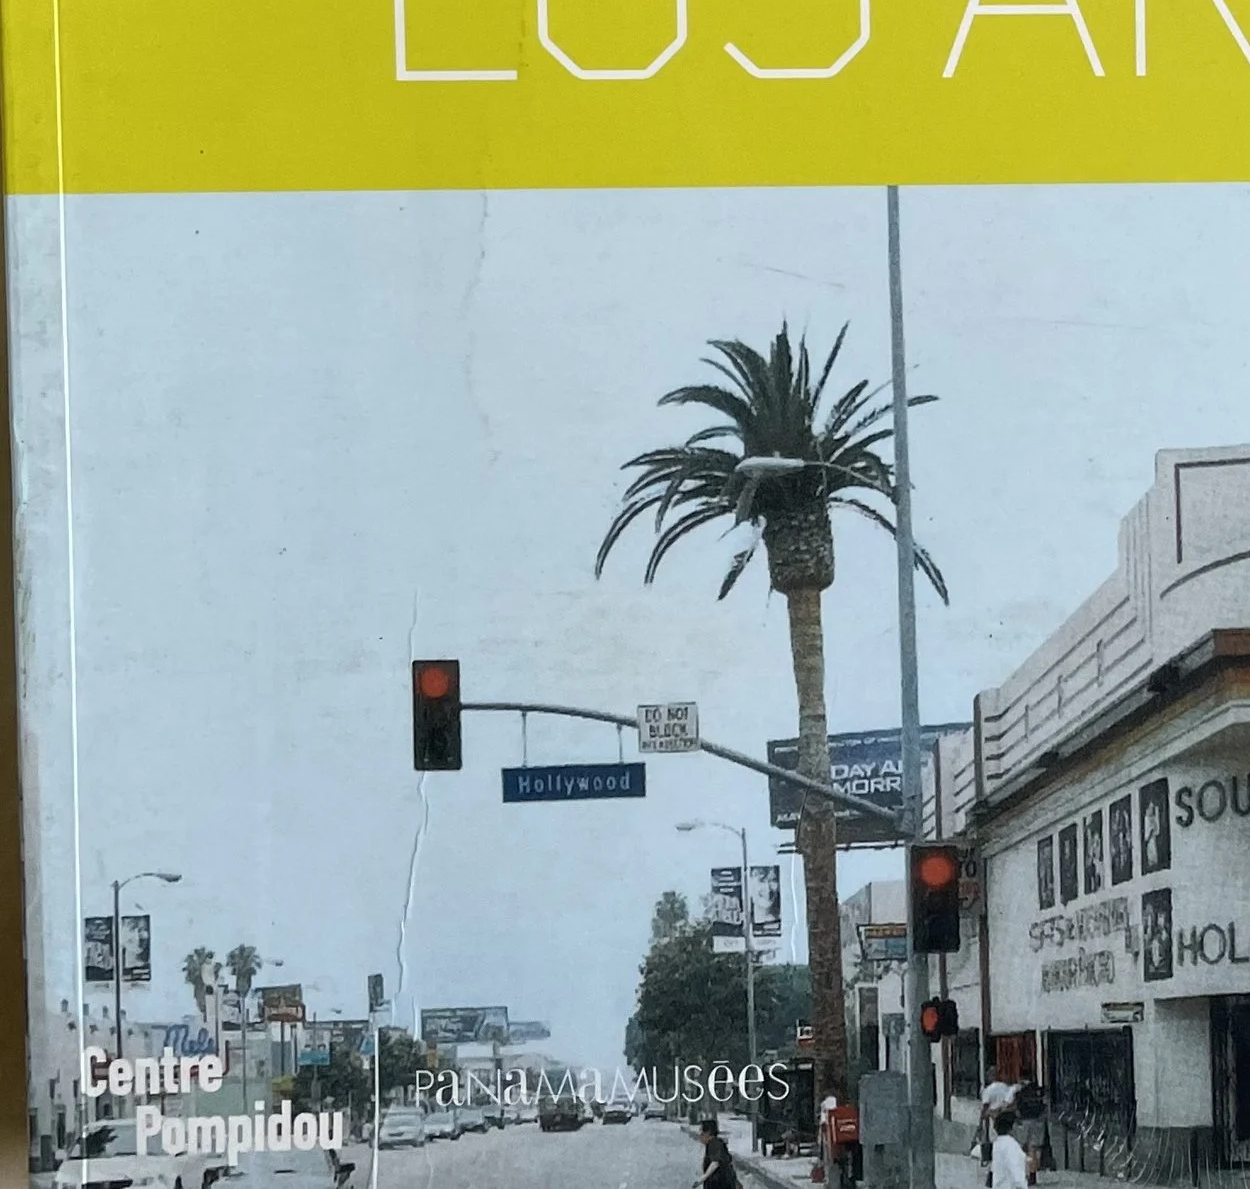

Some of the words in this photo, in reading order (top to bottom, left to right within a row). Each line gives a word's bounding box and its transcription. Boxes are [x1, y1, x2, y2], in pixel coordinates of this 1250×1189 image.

[831, 763, 876, 780] DAY
[880, 759, 903, 775] A
[518, 772, 631, 796] Hollywood
[833, 777, 902, 795] MORR
[82, 1045, 223, 1098] Centre
[136, 1099, 343, 1167] Pompidou
